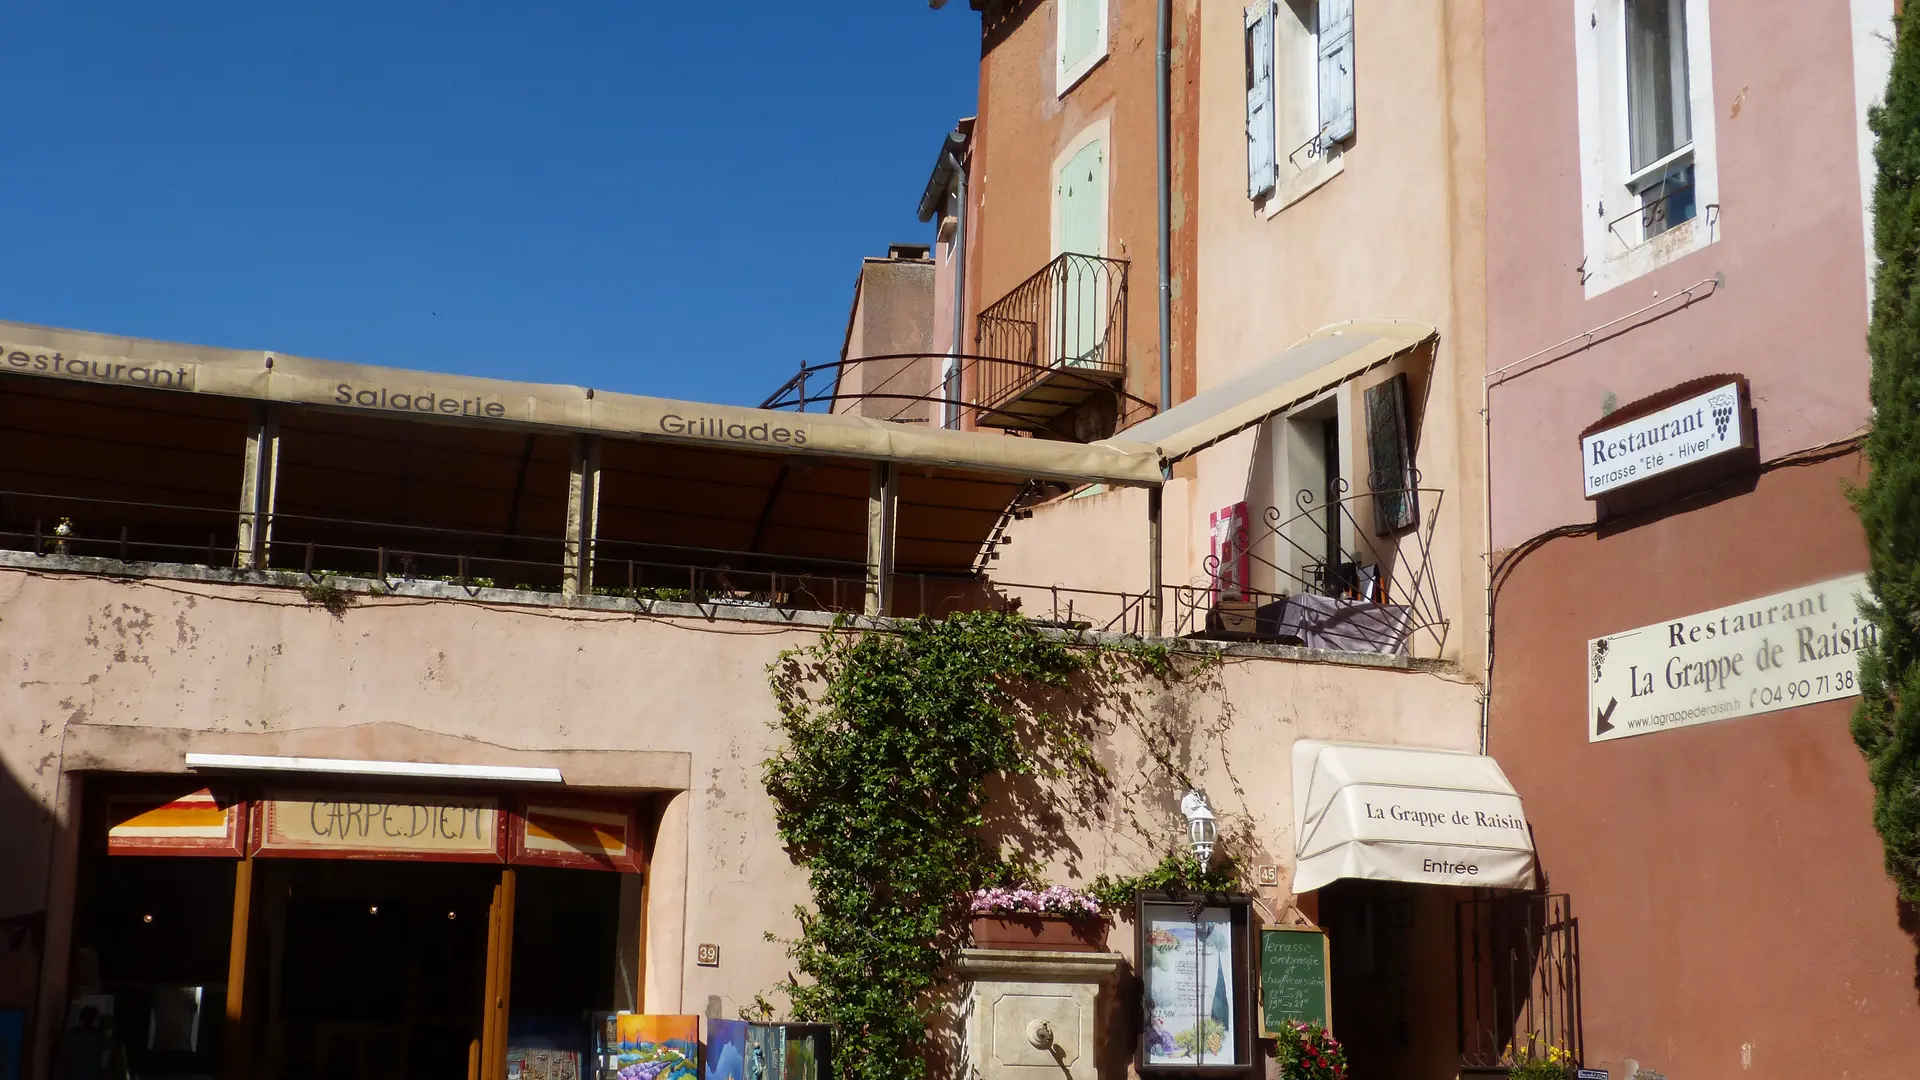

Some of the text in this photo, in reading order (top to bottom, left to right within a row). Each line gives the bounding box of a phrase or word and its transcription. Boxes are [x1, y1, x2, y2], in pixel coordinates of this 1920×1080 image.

[0, 345, 187, 388] estaurant
[335, 383, 506, 417] Saladerie
[659, 404, 807, 444] Grillades
[1592, 407, 1704, 466] Restaurant
[1589, 463, 1637, 489] Terrasse
[1668, 591, 1828, 648] Restaurant
[1629, 616, 1878, 698] La Grappe de Raisin
[1761, 685, 1782, 705] 04
[1788, 680, 1811, 700] 90
[1816, 675, 1829, 695] 71
[1835, 670, 1854, 691] 38
[1365, 803, 1524, 831] La Grappe de Raisin
[1261, 868, 1275, 880] 45
[1423, 858, 1479, 875] Entrée
[699, 946, 716, 960] 39
[1262, 931, 1312, 954] Terrasse
[1269, 952, 1320, 973] ombragée
[1285, 965, 1296, 975] et
